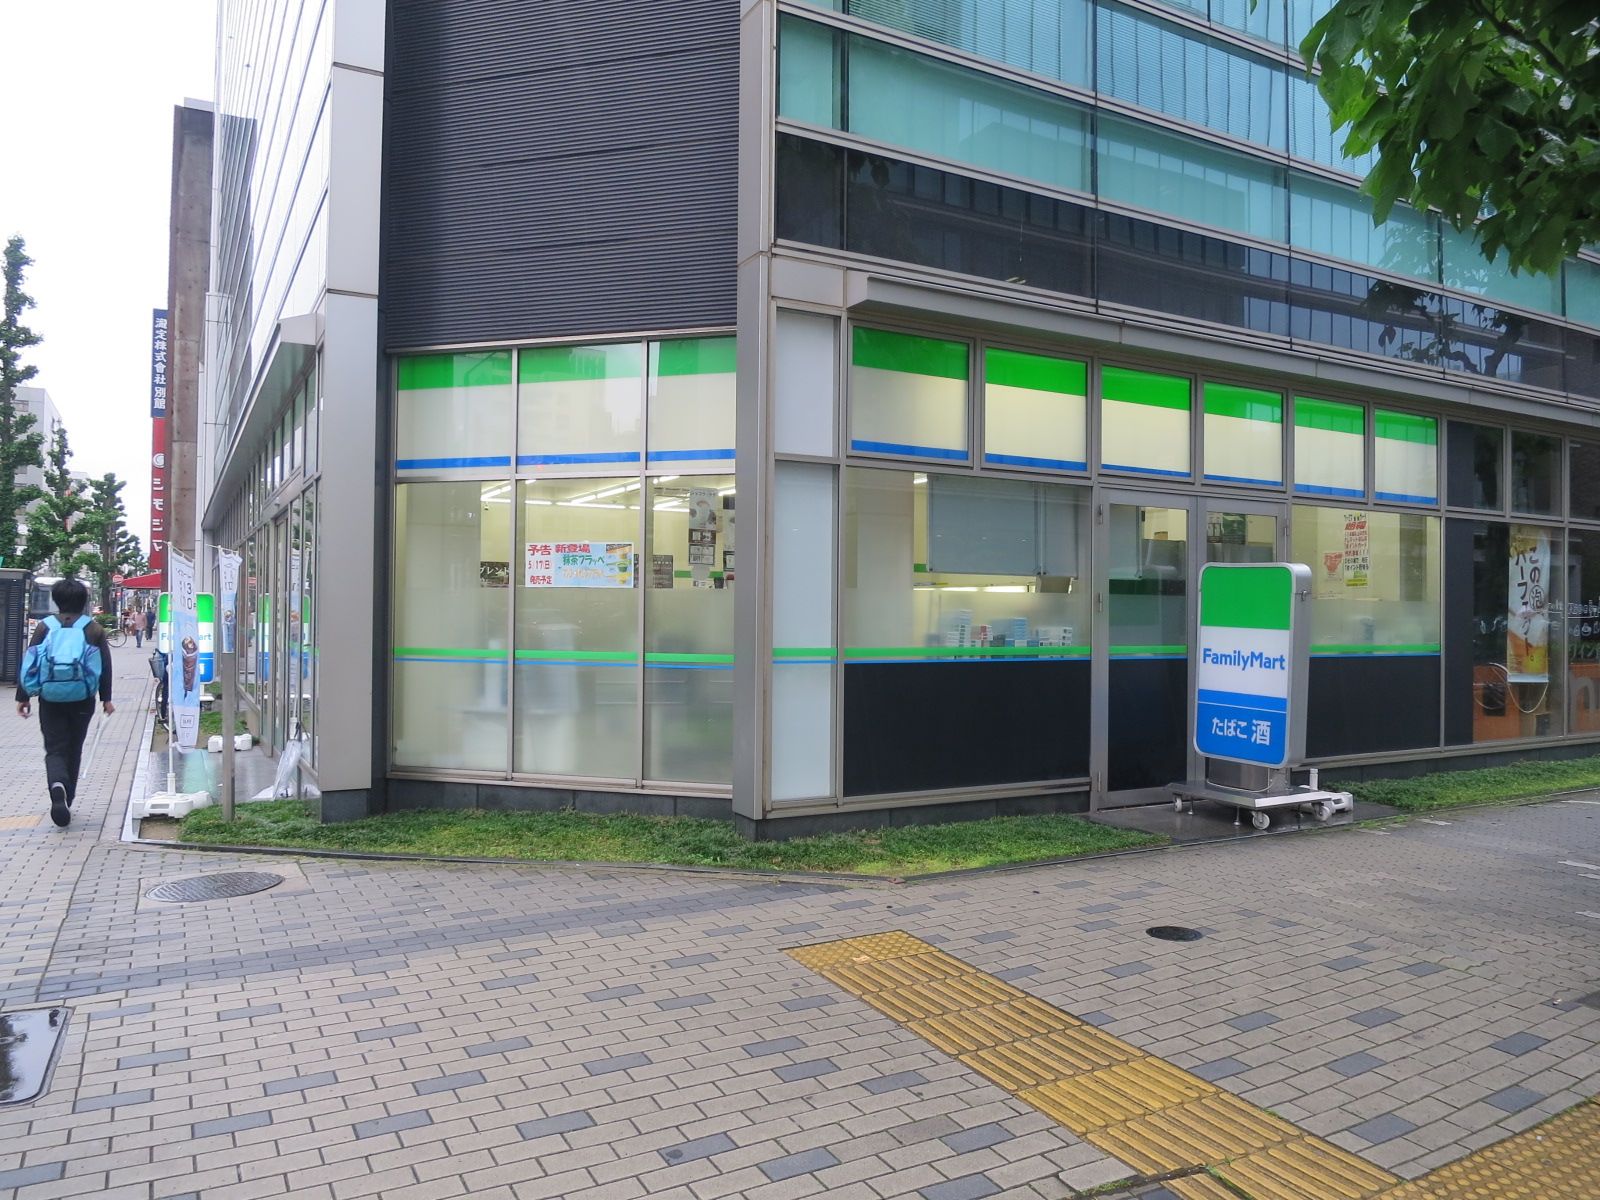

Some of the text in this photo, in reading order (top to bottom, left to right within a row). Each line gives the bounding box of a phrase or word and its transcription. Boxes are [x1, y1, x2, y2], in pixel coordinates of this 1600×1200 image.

[528, 543, 591, 556] 予告 新登場
[1202, 647, 1286, 671] FamilyMart
[1211, 716, 1272, 746] たばこ 酒
